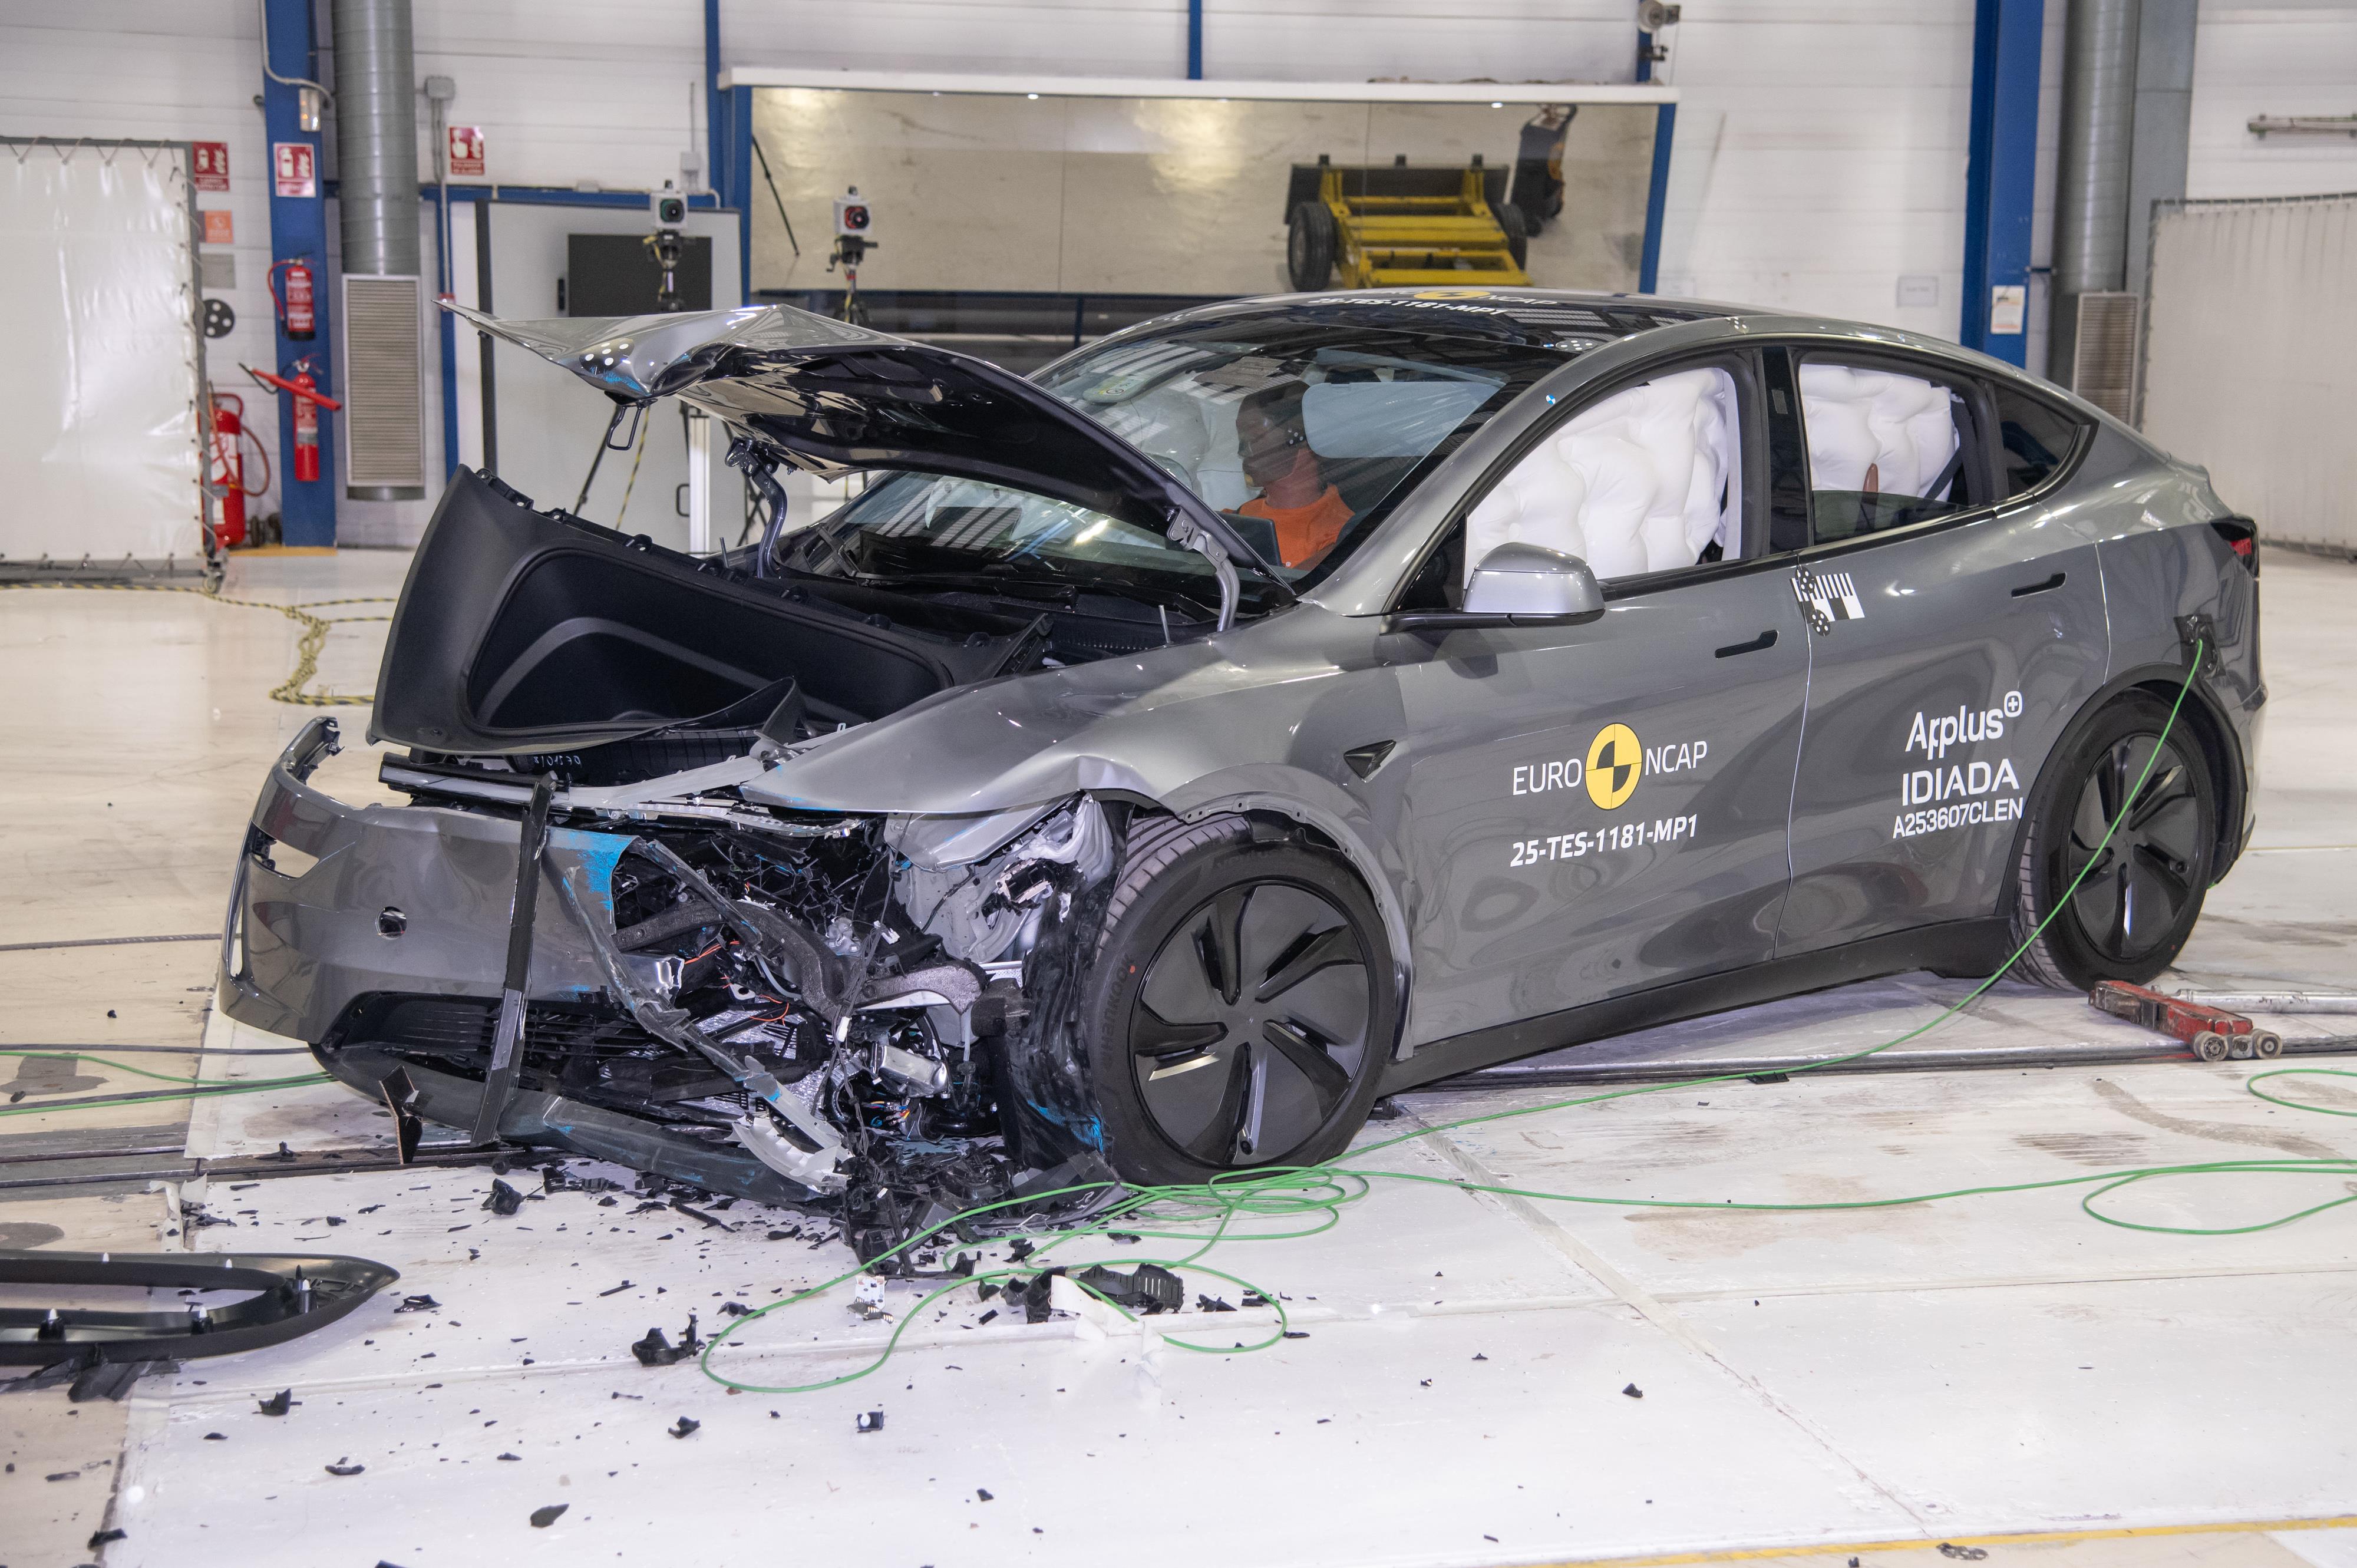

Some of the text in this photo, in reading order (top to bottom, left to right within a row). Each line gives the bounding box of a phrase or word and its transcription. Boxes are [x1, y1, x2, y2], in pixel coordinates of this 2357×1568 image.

[1308, 298, 1508, 315] 25-TES-1181-MP1
[1478, 295, 1558, 305] NCAP
[1513, 740, 1708, 795] EURO NCAP
[1902, 758, 2020, 807] IDIADA
[1510, 814, 1697, 867] 25-TES-1181-MP1
[1893, 797, 2023, 839] A253607CLEN
